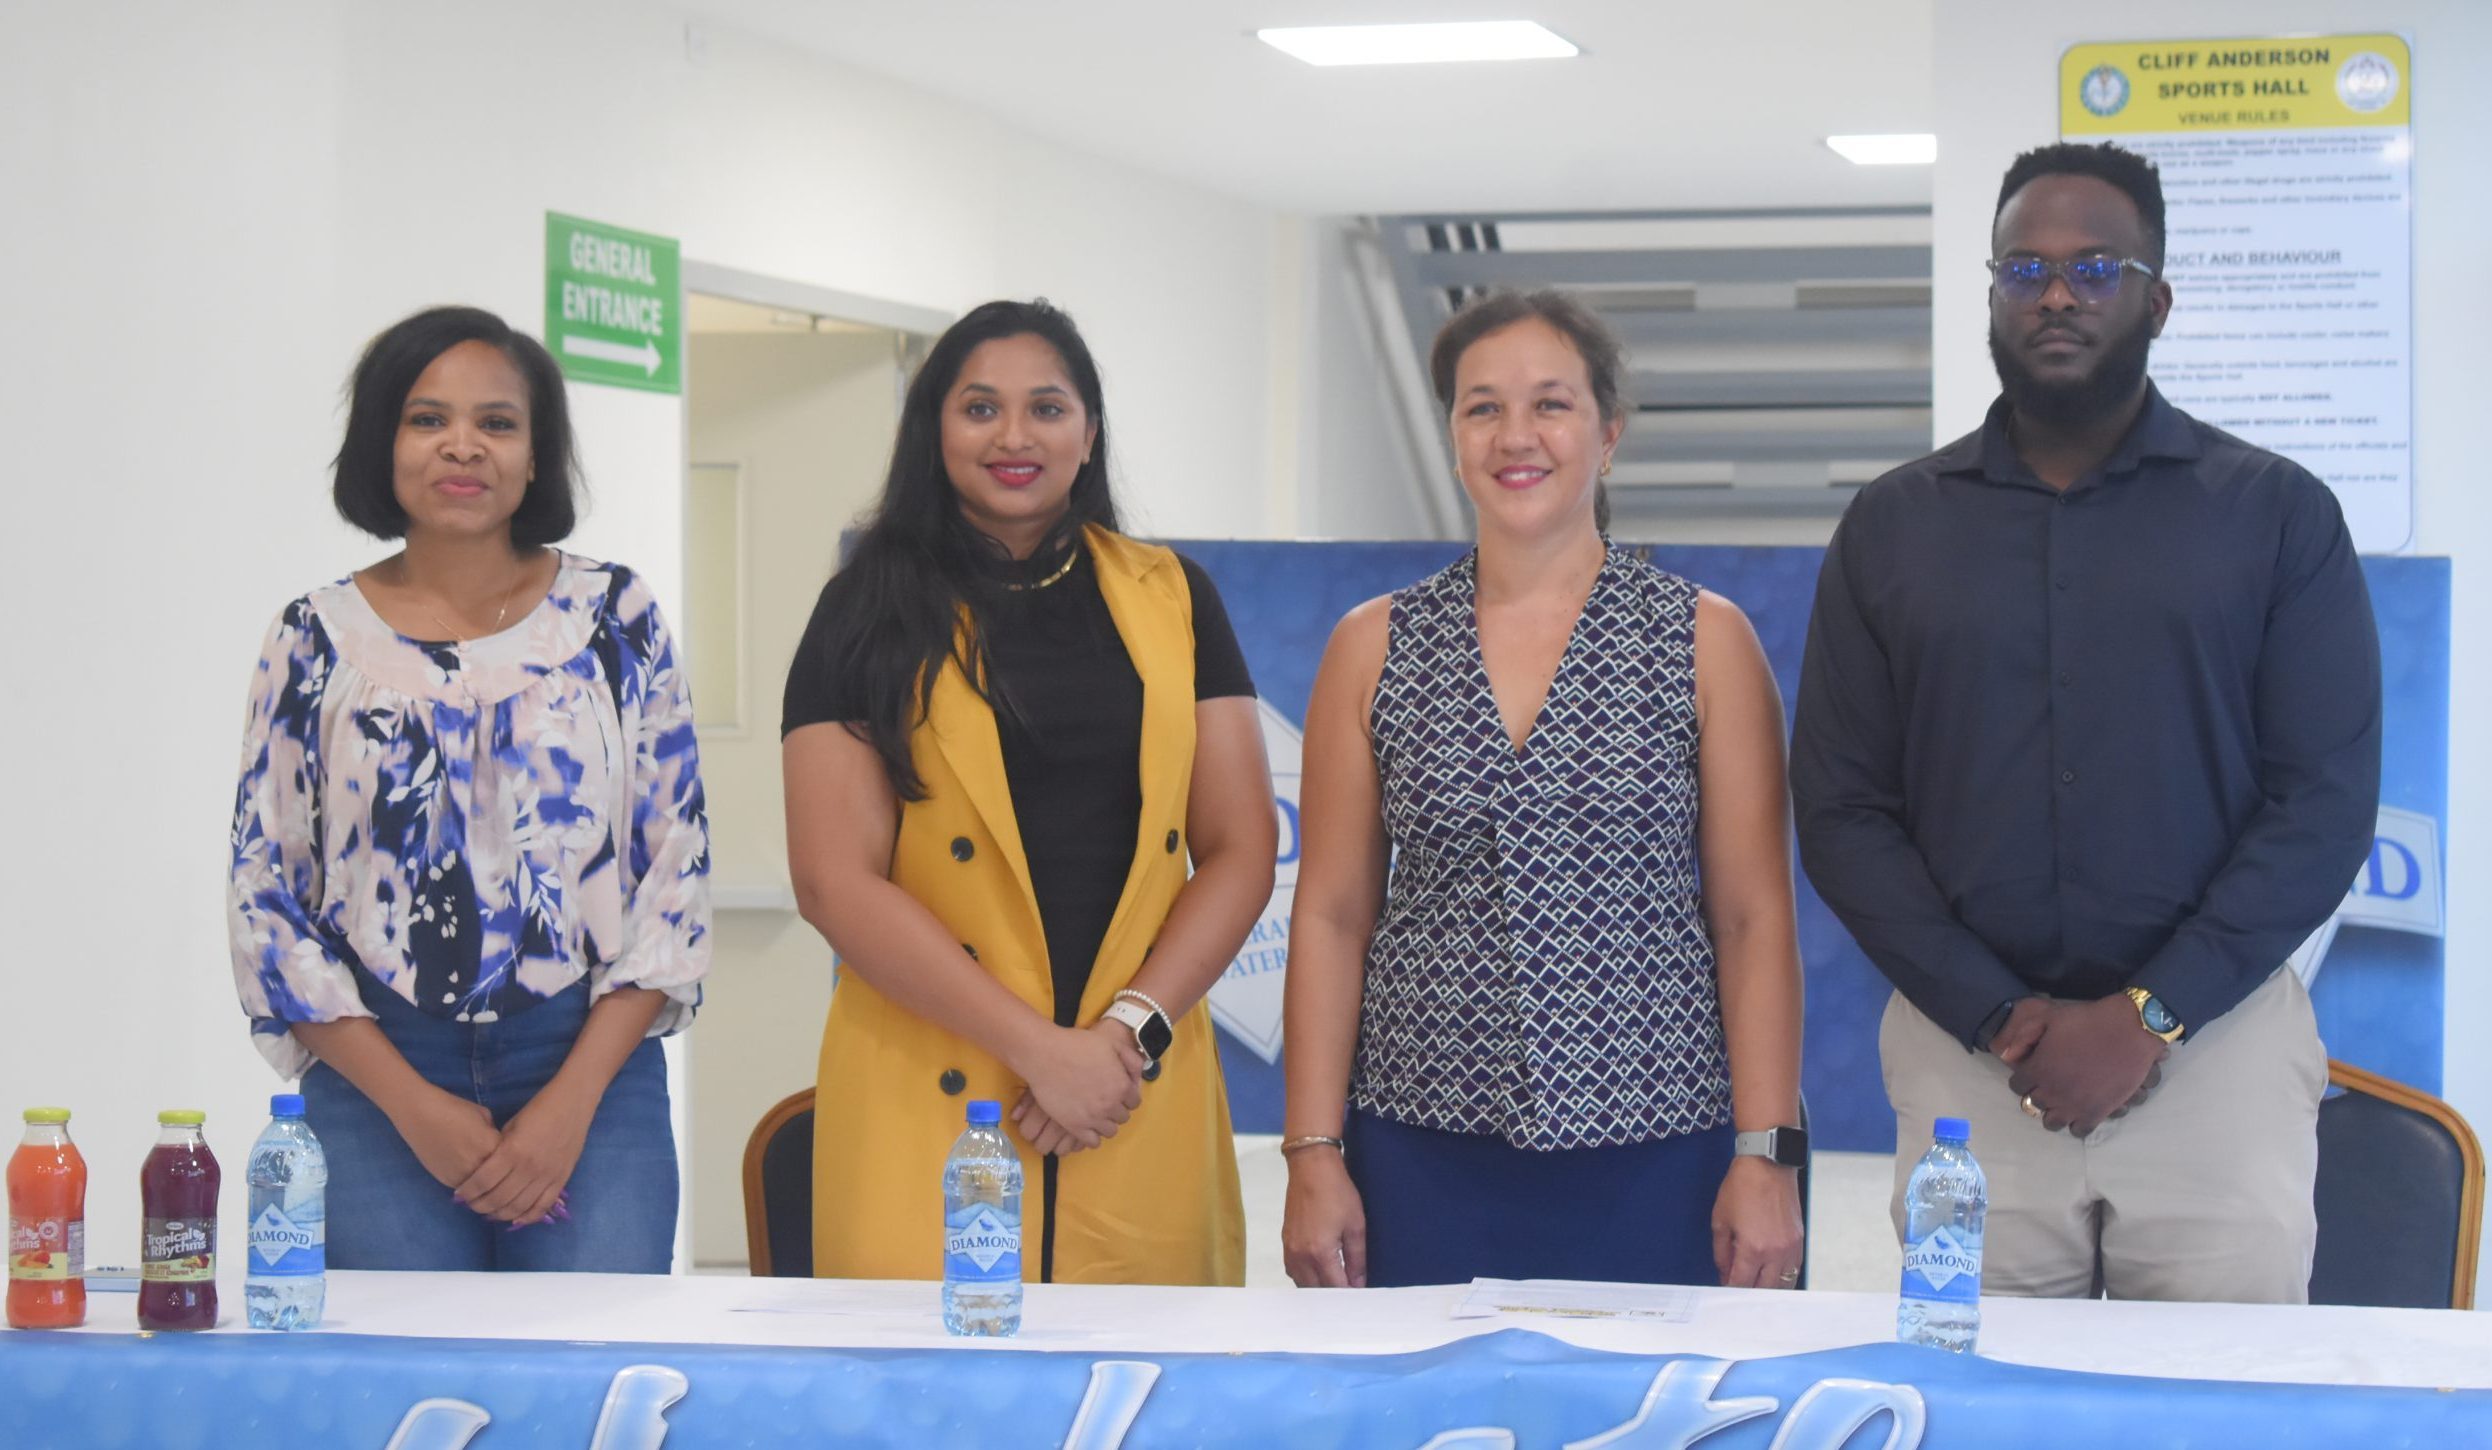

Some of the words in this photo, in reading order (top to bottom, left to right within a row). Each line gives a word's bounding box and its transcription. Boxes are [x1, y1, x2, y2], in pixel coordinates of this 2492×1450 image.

[2138, 52, 2198, 70] CLIFF
[2207, 47, 2331, 68] ANDERSON
[2158, 81, 2245, 99] SPORTS
[2252, 78, 2310, 96] HALL
[2178, 110, 2232, 125] VENUE
[2236, 109, 2290, 124] RULES
[570, 231, 657, 286] GENERAL
[2209, 251, 2243, 267] AND
[2248, 249, 2342, 265] BEHAVIOUR
[562, 279, 664, 337] ENTRANCE
[146, 1227, 192, 1249] Tropical
[951, 1236, 1017, 1251] DIAMOND
[150, 1240, 207, 1258] Rhythms
[1907, 1254, 1975, 1272] DIAMOND
